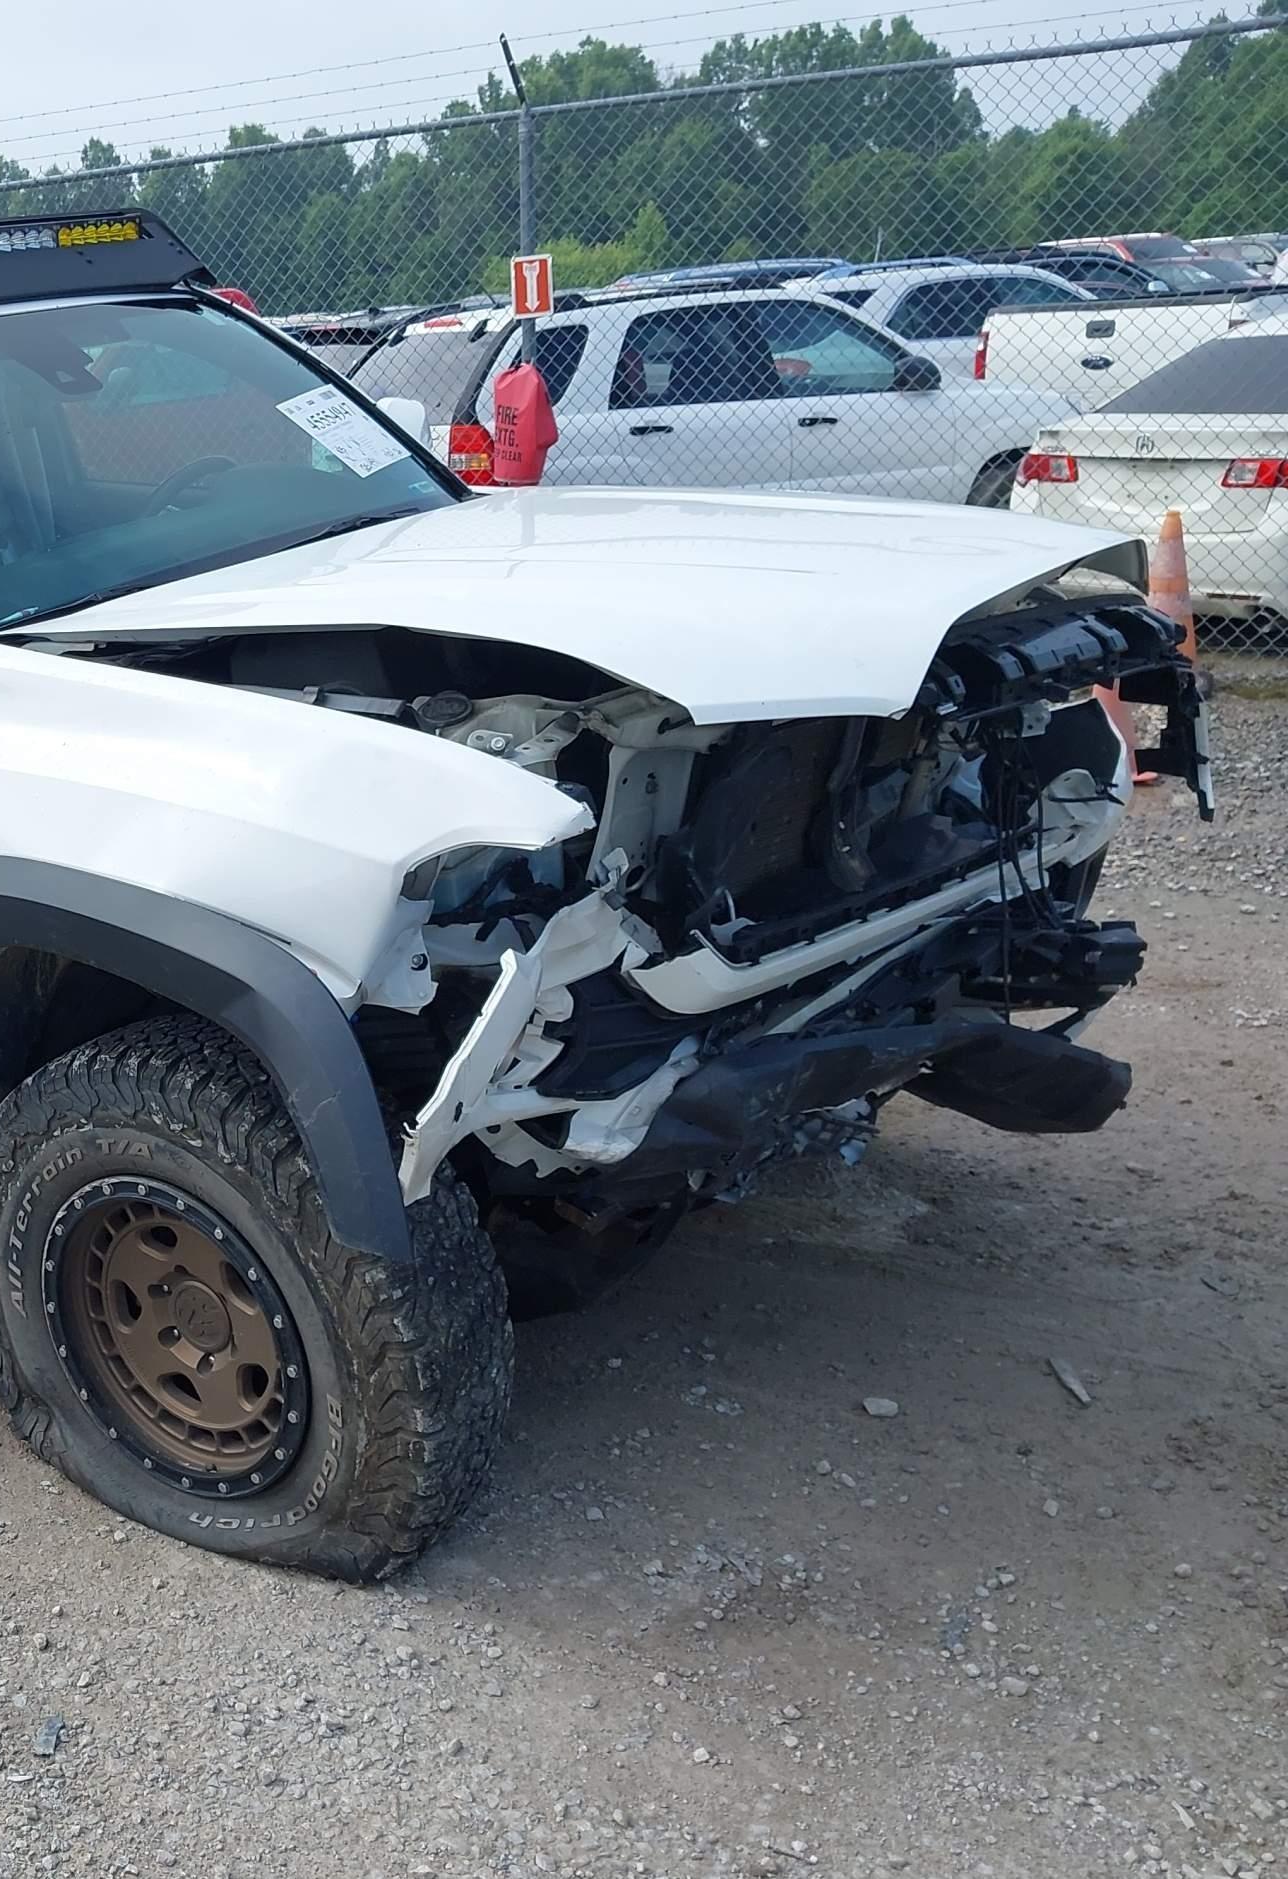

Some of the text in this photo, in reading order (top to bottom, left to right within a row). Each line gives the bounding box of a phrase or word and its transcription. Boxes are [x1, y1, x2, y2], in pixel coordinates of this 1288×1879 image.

[497, 404, 519, 426] FIRE
[8, 1138, 153, 1319] All-Terrain T/A
[188, 1393, 344, 1532] BFGoodrich
